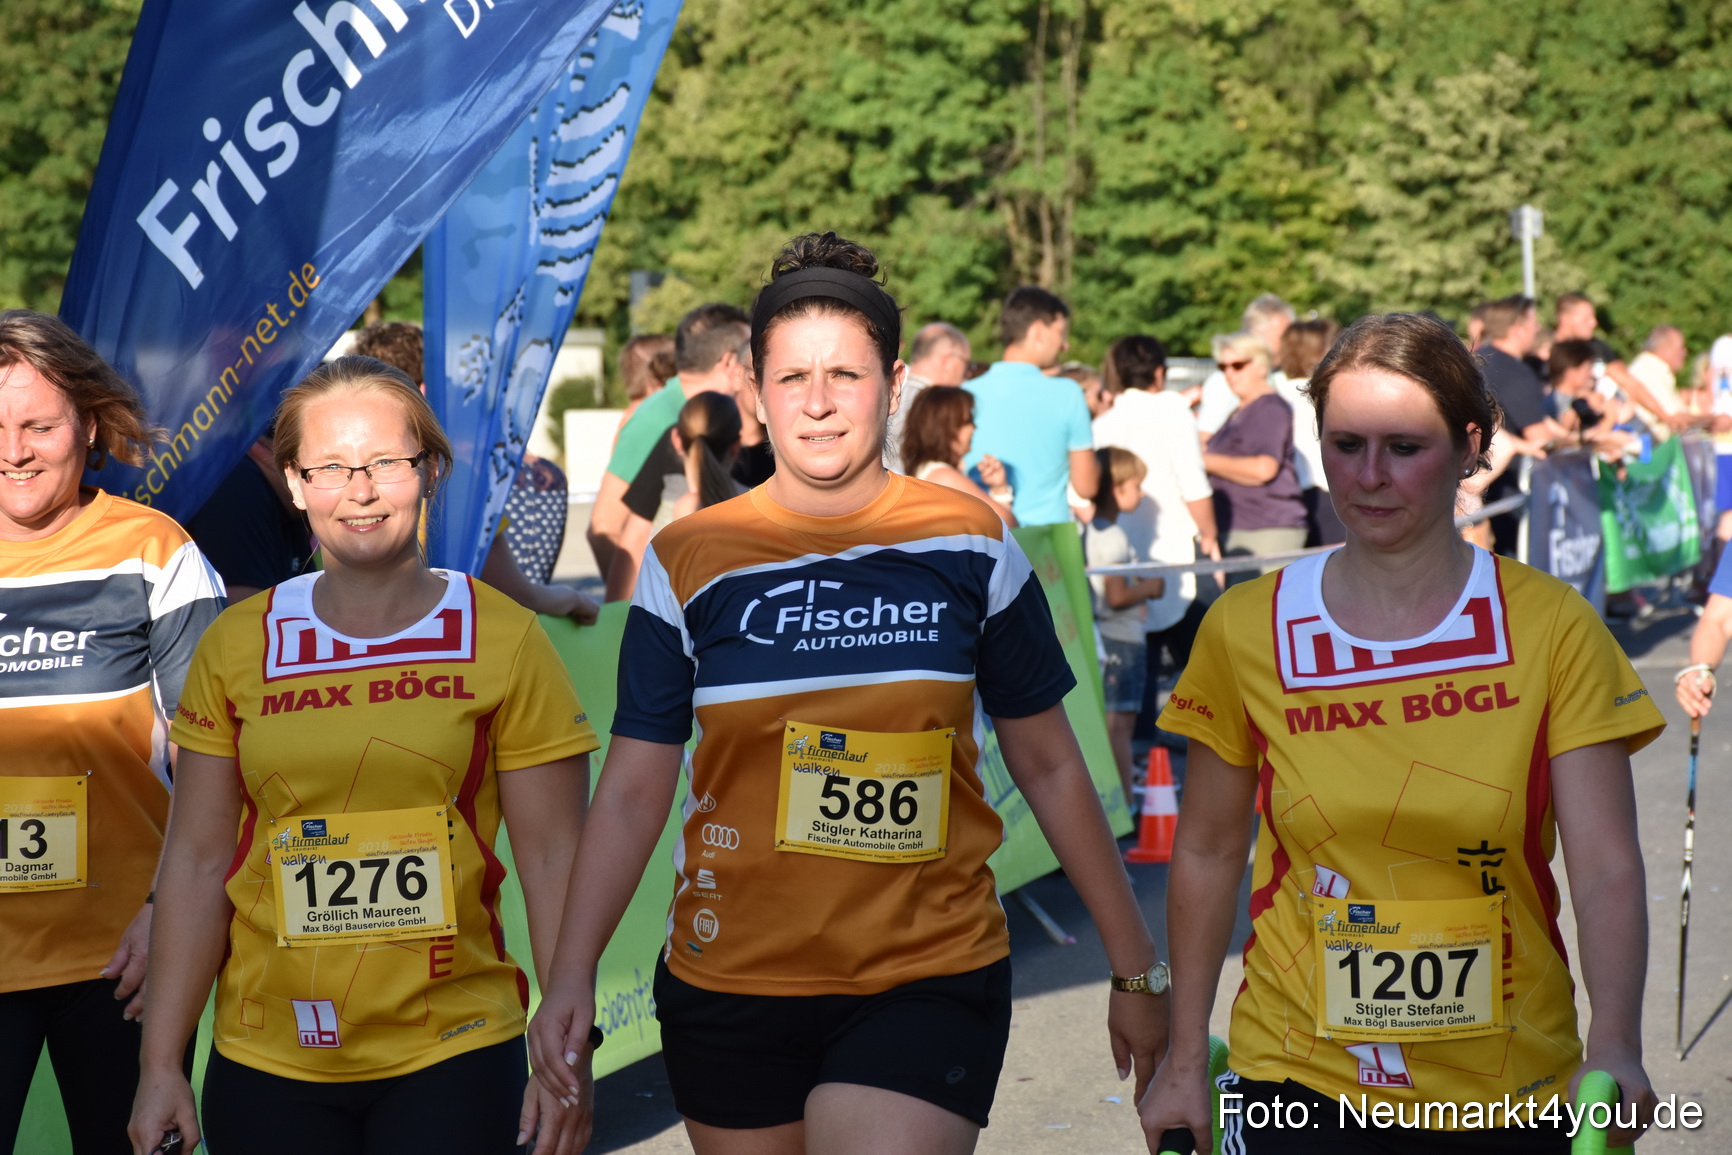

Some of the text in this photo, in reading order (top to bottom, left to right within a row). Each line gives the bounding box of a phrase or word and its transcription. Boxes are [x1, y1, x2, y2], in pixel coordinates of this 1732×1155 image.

[137, 0, 410, 290] Frisch
[123, 262, 321, 507] schmann-net.de
[775, 590, 948, 634] Fischer
[792, 630, 939, 652] AUTOMOBILE
[260, 670, 475, 716] MAX BÖGL
[1284, 682, 1520, 736] MAX BÖGL
[807, 745, 869, 763] firmenlauf
[819, 775, 919, 826] 586
[812, 820, 922, 840] Stigler Katharina
[0, 819, 47, 859] 13
[292, 833, 350, 847] firmenlauf
[807, 833, 841, 845] Fischer
[843, 839, 896, 850] Automobile
[898, 841, 923, 850] GmbH
[281, 853, 328, 866] walken
[702, 850, 716, 859] Audi
[5, 862, 54, 874] Dagmar
[31, 873, 57, 881] GmbH
[295, 855, 428, 908] 1276
[693, 891, 723, 901] SEAT
[307, 906, 421, 922] Gröllich Maureen
[302, 917, 427, 933] Max Bögl Bauservice GmbH
[699, 917, 714, 934] FIAT
[1337, 920, 1401, 934] firmenlauf
[1325, 939, 1374, 953] walken
[1338, 948, 1479, 1001] 1207
[1355, 1002, 1464, 1018] Stigler Stefanie
[1343, 1014, 1475, 1029] Max Bögl Bauservice GmbH
